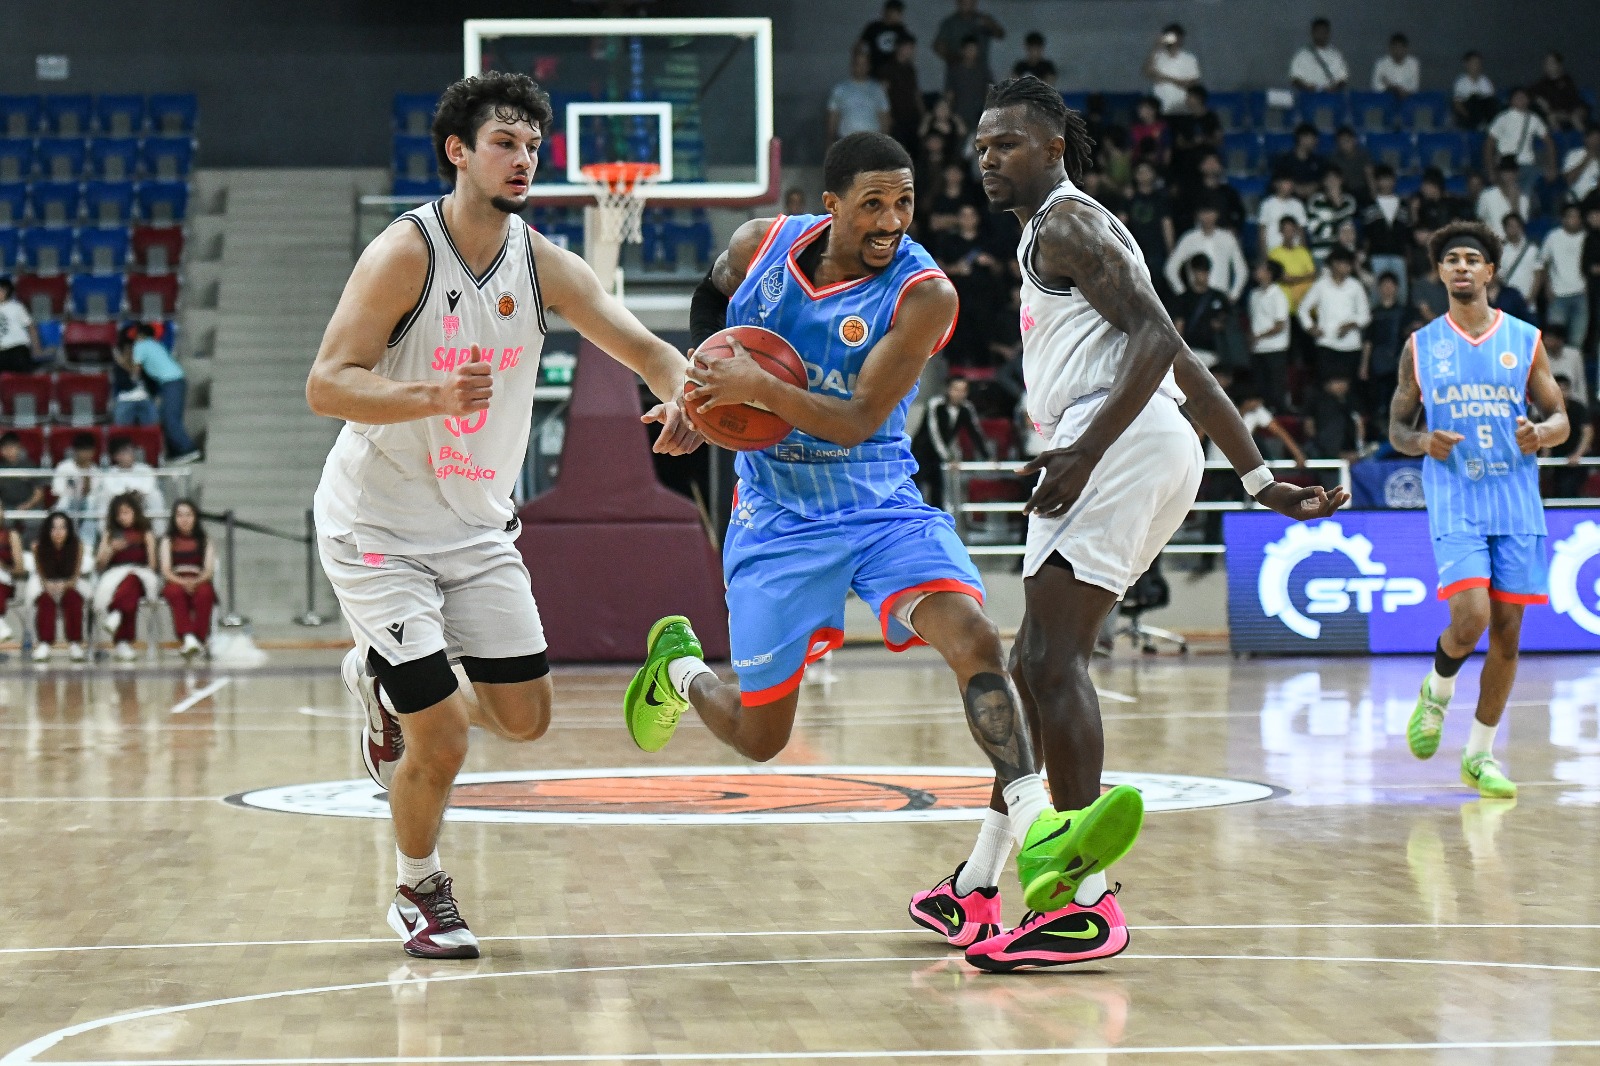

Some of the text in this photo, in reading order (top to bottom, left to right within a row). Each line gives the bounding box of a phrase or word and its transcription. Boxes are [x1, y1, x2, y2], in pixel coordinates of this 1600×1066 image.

[498, 345, 525, 372] BC
[1432, 384, 1523, 405] LANDAU
[1450, 401, 1511, 419] LIONS
[1476, 424, 1494, 450] 5
[1305, 577, 1427, 613] STP
